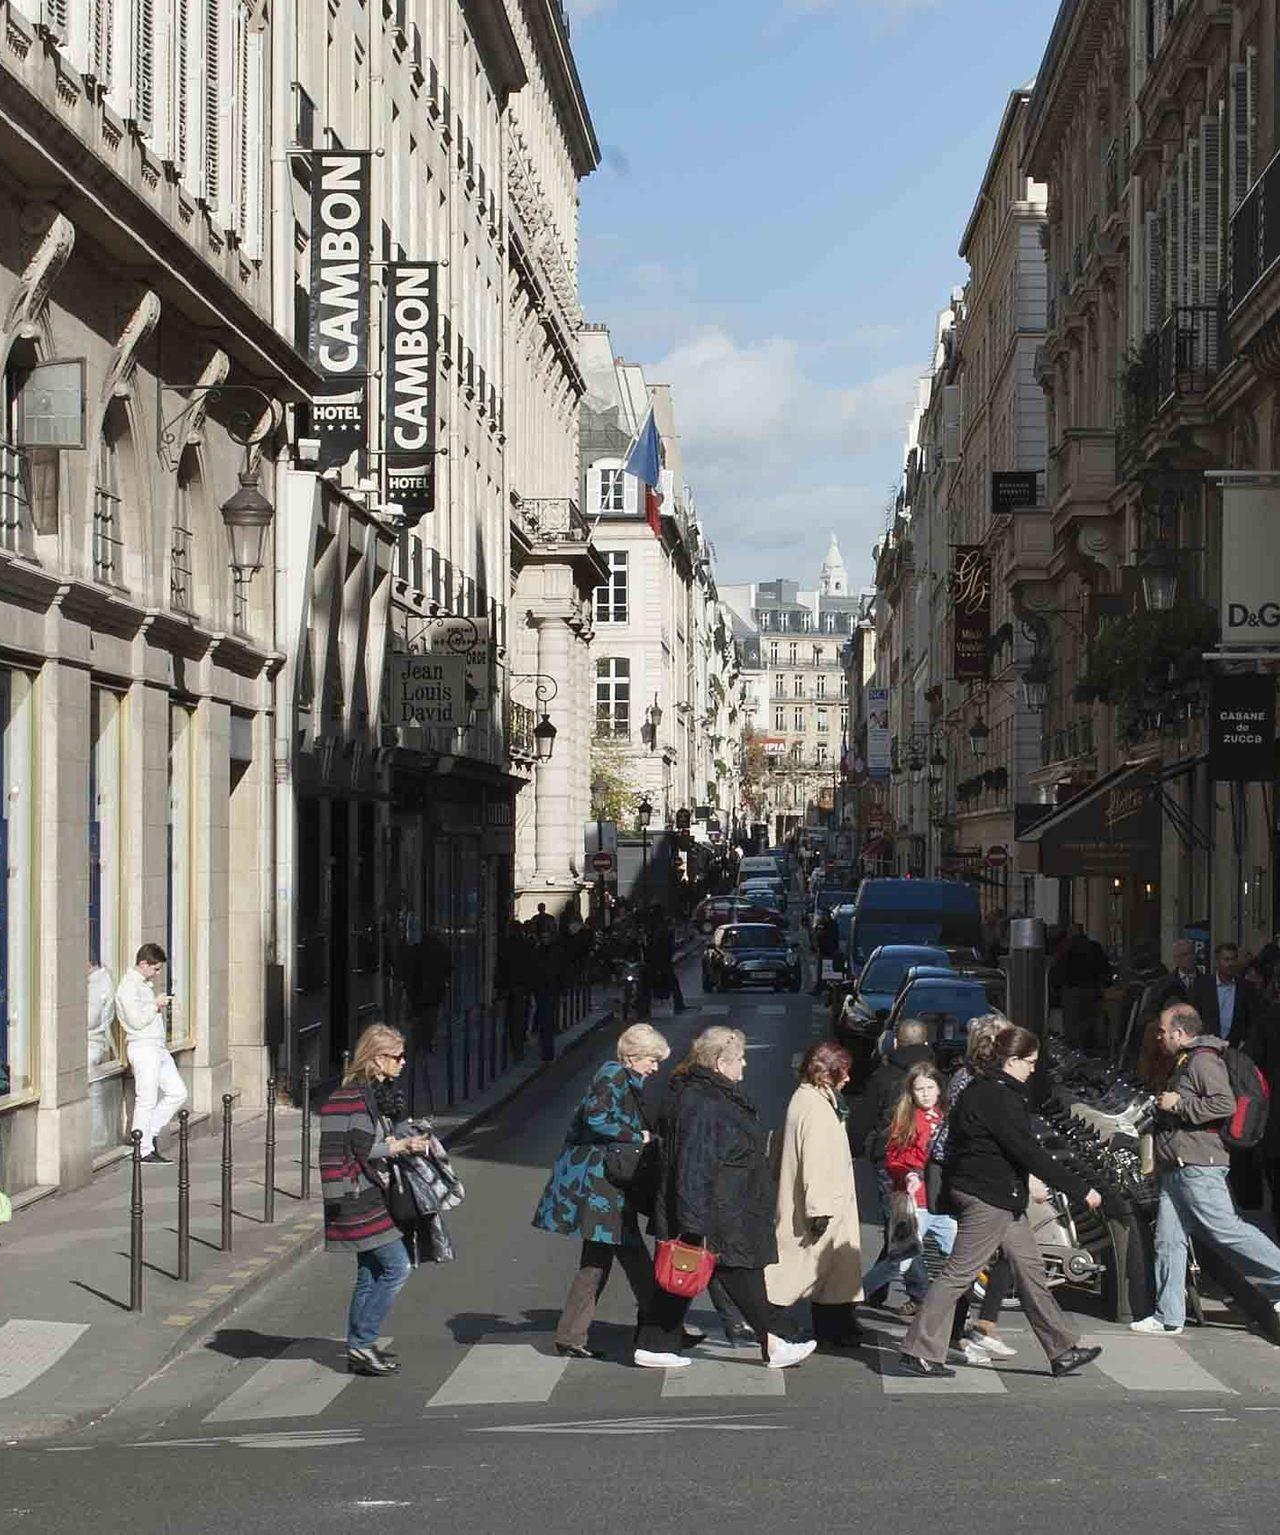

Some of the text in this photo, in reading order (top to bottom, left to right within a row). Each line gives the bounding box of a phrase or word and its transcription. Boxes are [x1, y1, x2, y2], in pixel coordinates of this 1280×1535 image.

[319, 156, 361, 373] CAMBON
[393, 267, 430, 450] CAMBON
[312, 406, 362, 421] HOTEL
[388, 476, 430, 490] HOTEL
[401, 660, 444, 681] Jean
[400, 681, 453, 702] Louis
[400, 702, 453, 723] David
